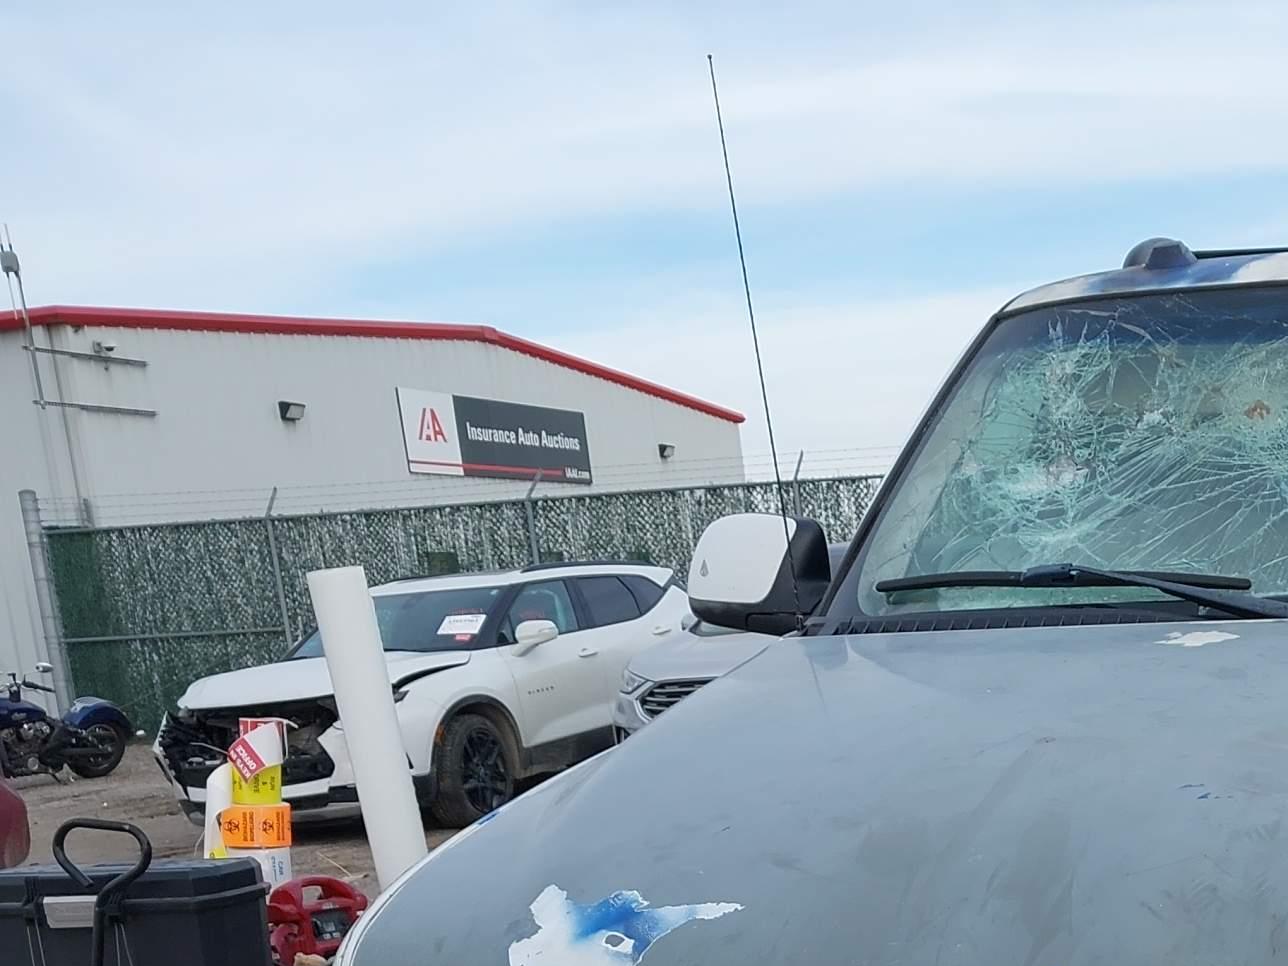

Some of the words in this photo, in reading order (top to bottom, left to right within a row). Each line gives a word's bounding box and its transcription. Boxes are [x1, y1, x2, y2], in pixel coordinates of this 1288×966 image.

[466, 421, 516, 444] Insurance
[518, 427, 540, 447] Auto
[541, 430, 580, 451] Auctions
[234, 744, 257, 770] OFFICE
